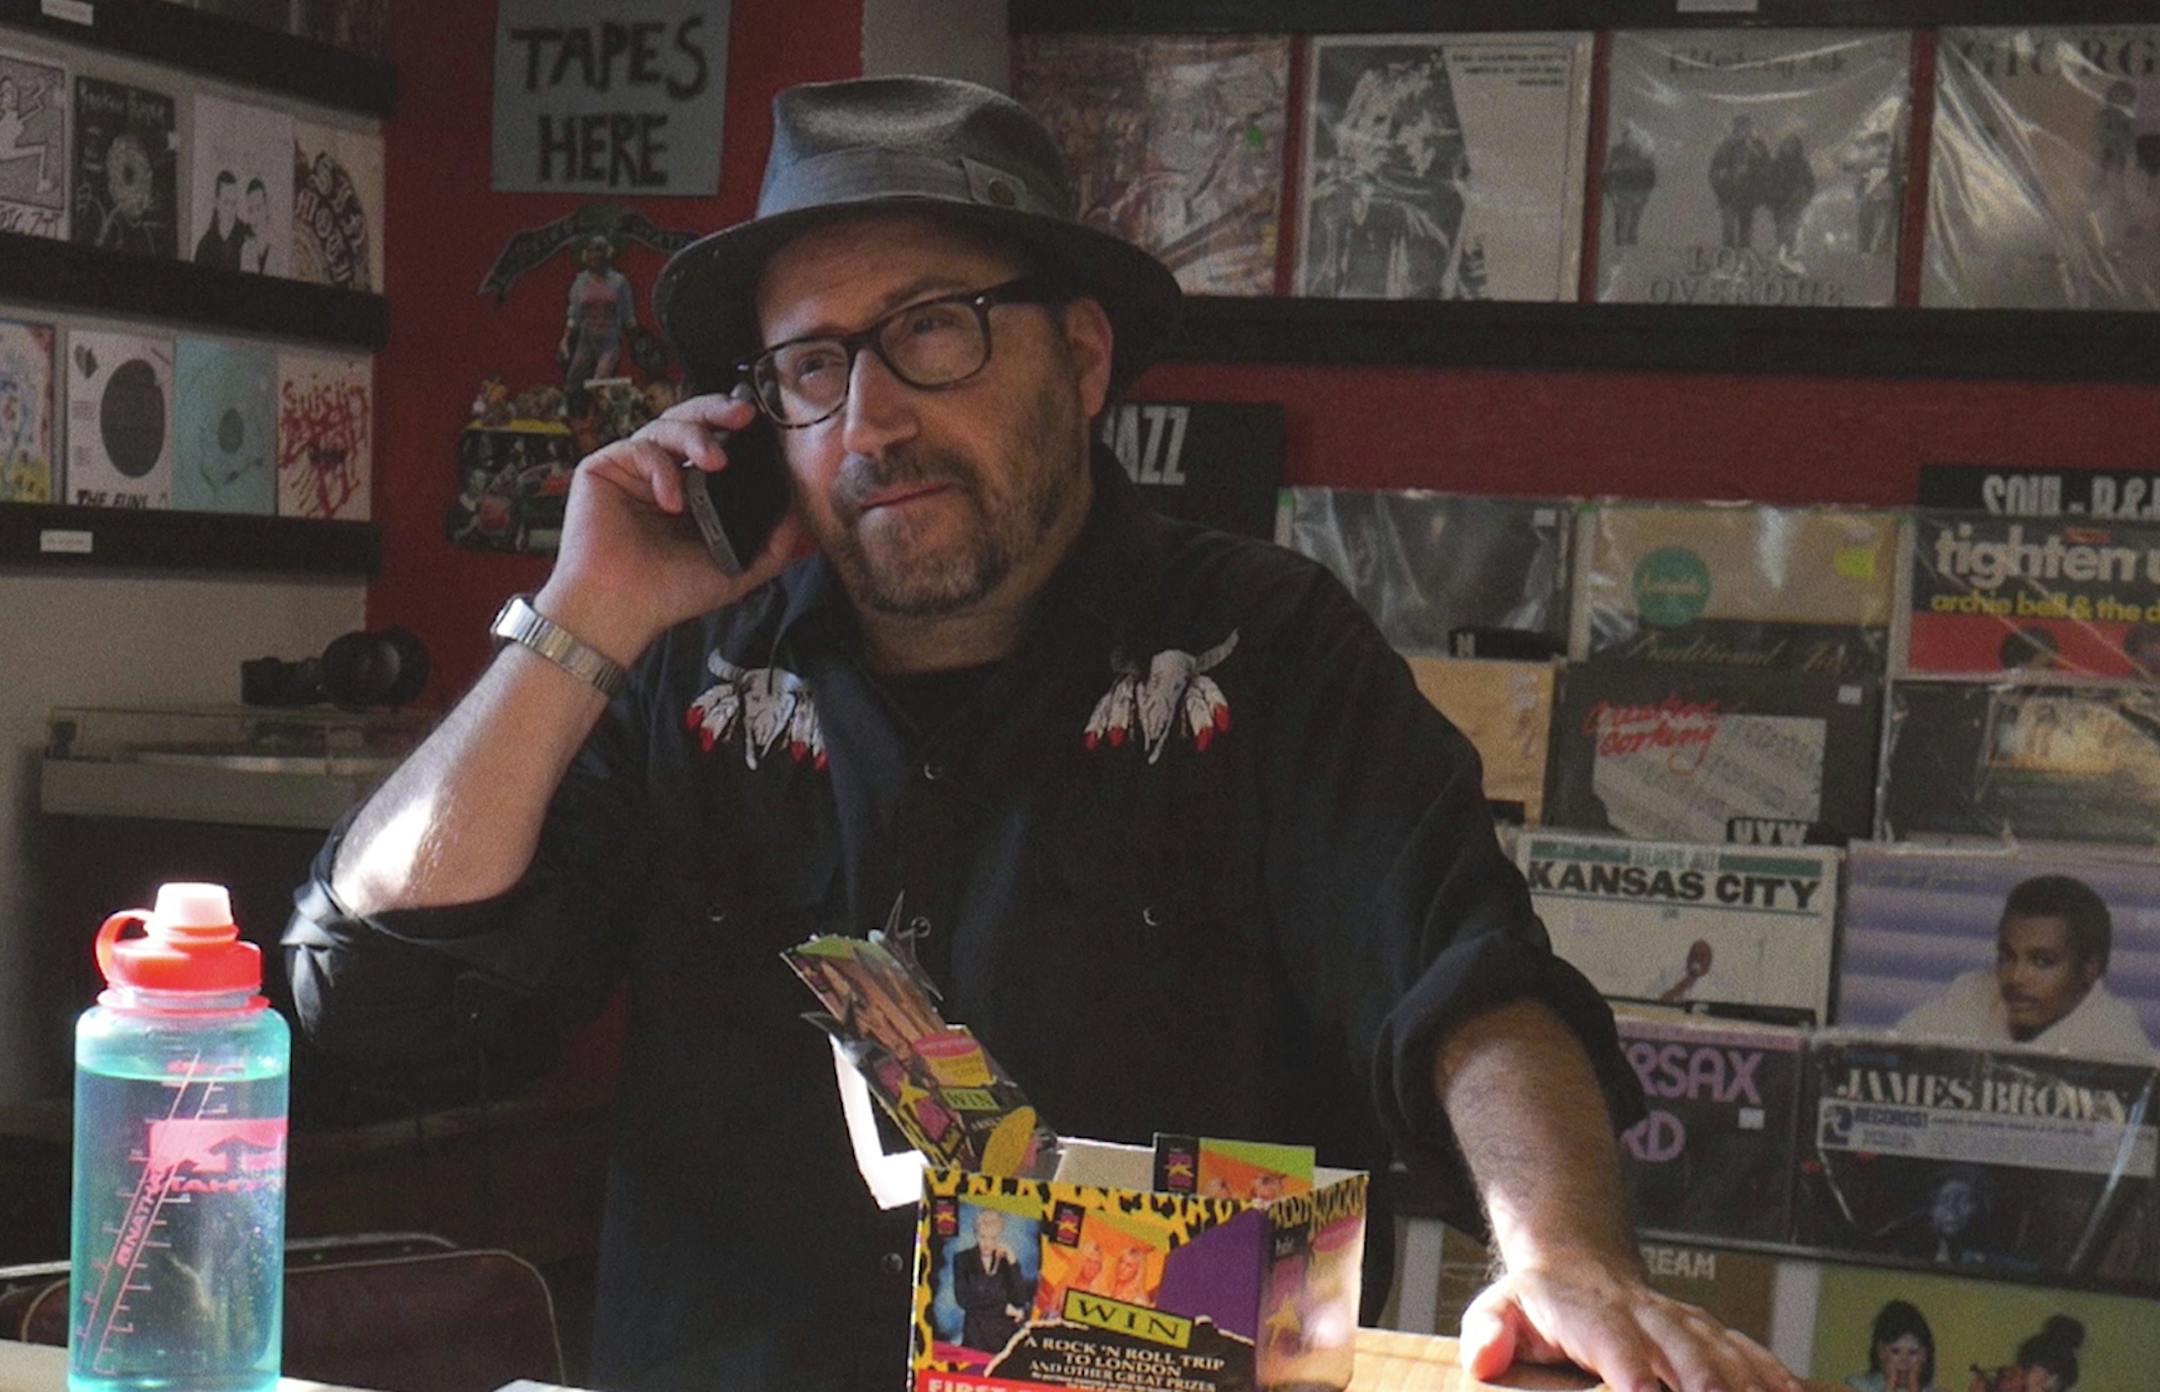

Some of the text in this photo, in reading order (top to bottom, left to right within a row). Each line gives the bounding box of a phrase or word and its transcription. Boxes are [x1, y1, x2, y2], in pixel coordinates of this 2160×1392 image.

[510, 15, 708, 101] TAPES
[538, 112, 668, 187] HERE
[2092, 476, 2160, 520] R&
[1936, 524, 2137, 590] tighten
[1931, 590, 2012, 615] archie
[2017, 592, 2068, 618] bell
[2096, 594, 2142, 622] the
[1733, 820, 1808, 845] UVW
[1529, 860, 1822, 909] KANSAS CITY
[1619, 1042, 1763, 1105] RSAX
[1836, 1068, 1974, 1109] JAMES
[1980, 1077, 2128, 1127] BROWN
[1077, 1298, 1181, 1341] WIN
[1024, 1336, 1038, 1348] A
[1042, 1338, 1097, 1355] ROCK
[1125, 1347, 1176, 1365] ROLL
[1179, 1355, 1225, 1371] TRIP
[1064, 1352, 1182, 1376] TO LONDON
[928, 1379, 1006, 1392] FIR
[1029, 1360, 1062, 1373] AND
[1064, 1364, 1114, 1380] OTHER
[1116, 1370, 1164, 1386] GREAT
[1166, 1377, 1216, 1392] PRIZES
